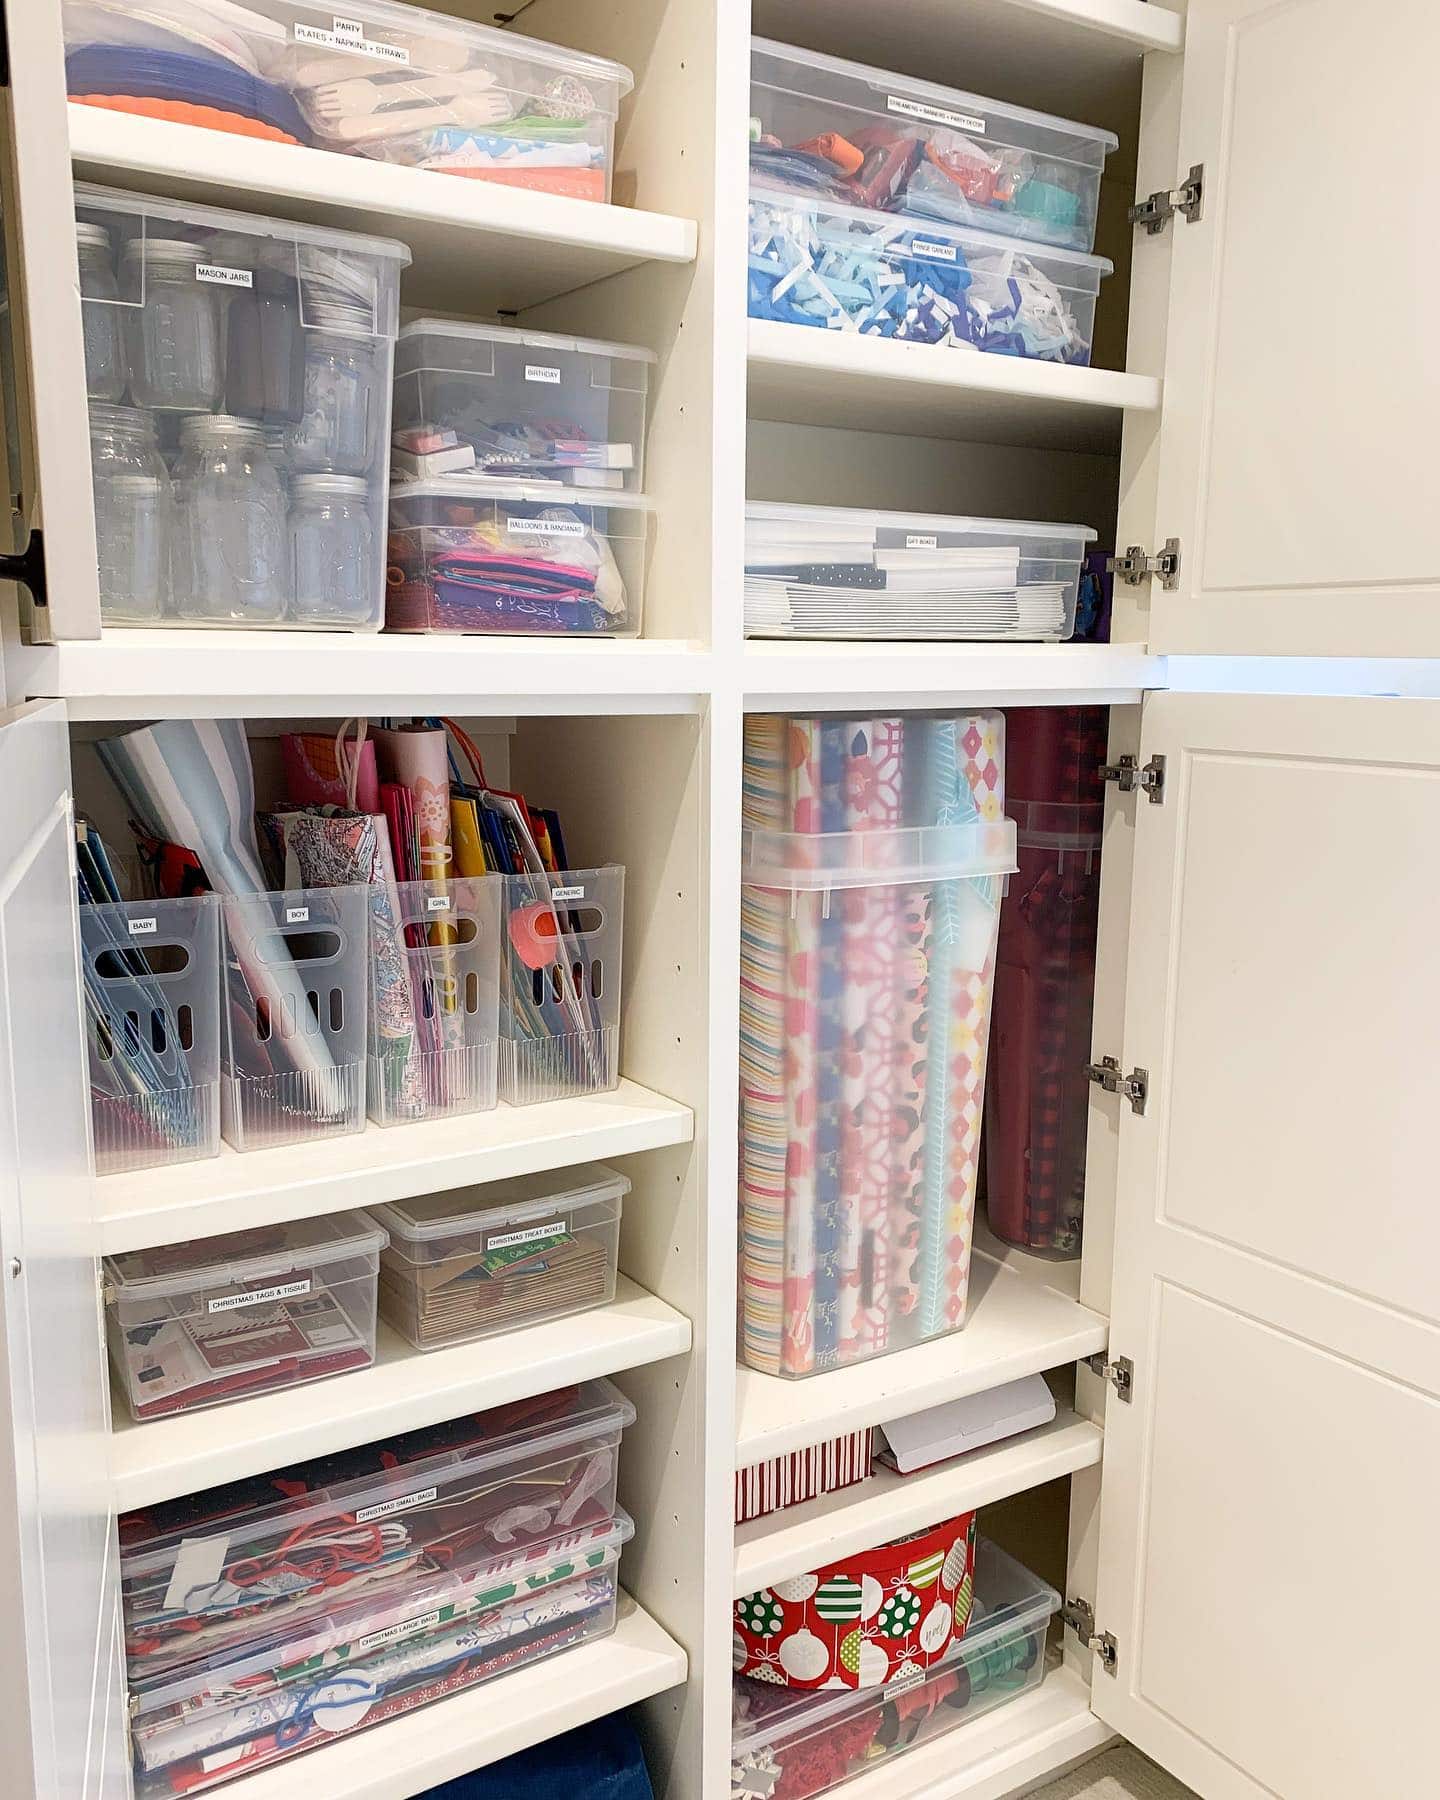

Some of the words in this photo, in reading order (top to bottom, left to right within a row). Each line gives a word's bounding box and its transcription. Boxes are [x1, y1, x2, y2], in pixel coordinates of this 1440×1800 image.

[336, 21, 361, 33] PARTY
[297, 28, 327, 42] PLATES
[335, 37, 368, 52] NAPKINS
[375, 46, 407, 60] STRAWS
[198, 268, 228, 279] MASON
[229, 273, 250, 282] JARS
[432, 899, 447, 907] GIRL
[291, 910, 306, 919] BOY
[132, 921, 153, 930] BABY
[490, 1234, 524, 1247] CHRISTMAS
[524, 1229, 543, 1239] TREAT
[544, 1224, 563, 1234] BOXES
[212, 1295, 254, 1310] CHRISTMAS
[256, 1291, 275, 1300] TAGS
[284, 1283, 308, 1294] TISSUE
[358, 1503, 395, 1519] CHRISTMAS
[396, 1497, 416, 1508] SMALL
[417, 1490, 434, 1501] BAGS
[361, 1628, 399, 1646] CHRISTMAS
[399, 1621, 420, 1633] LARGE
[420, 1614, 438, 1625] BAGS
